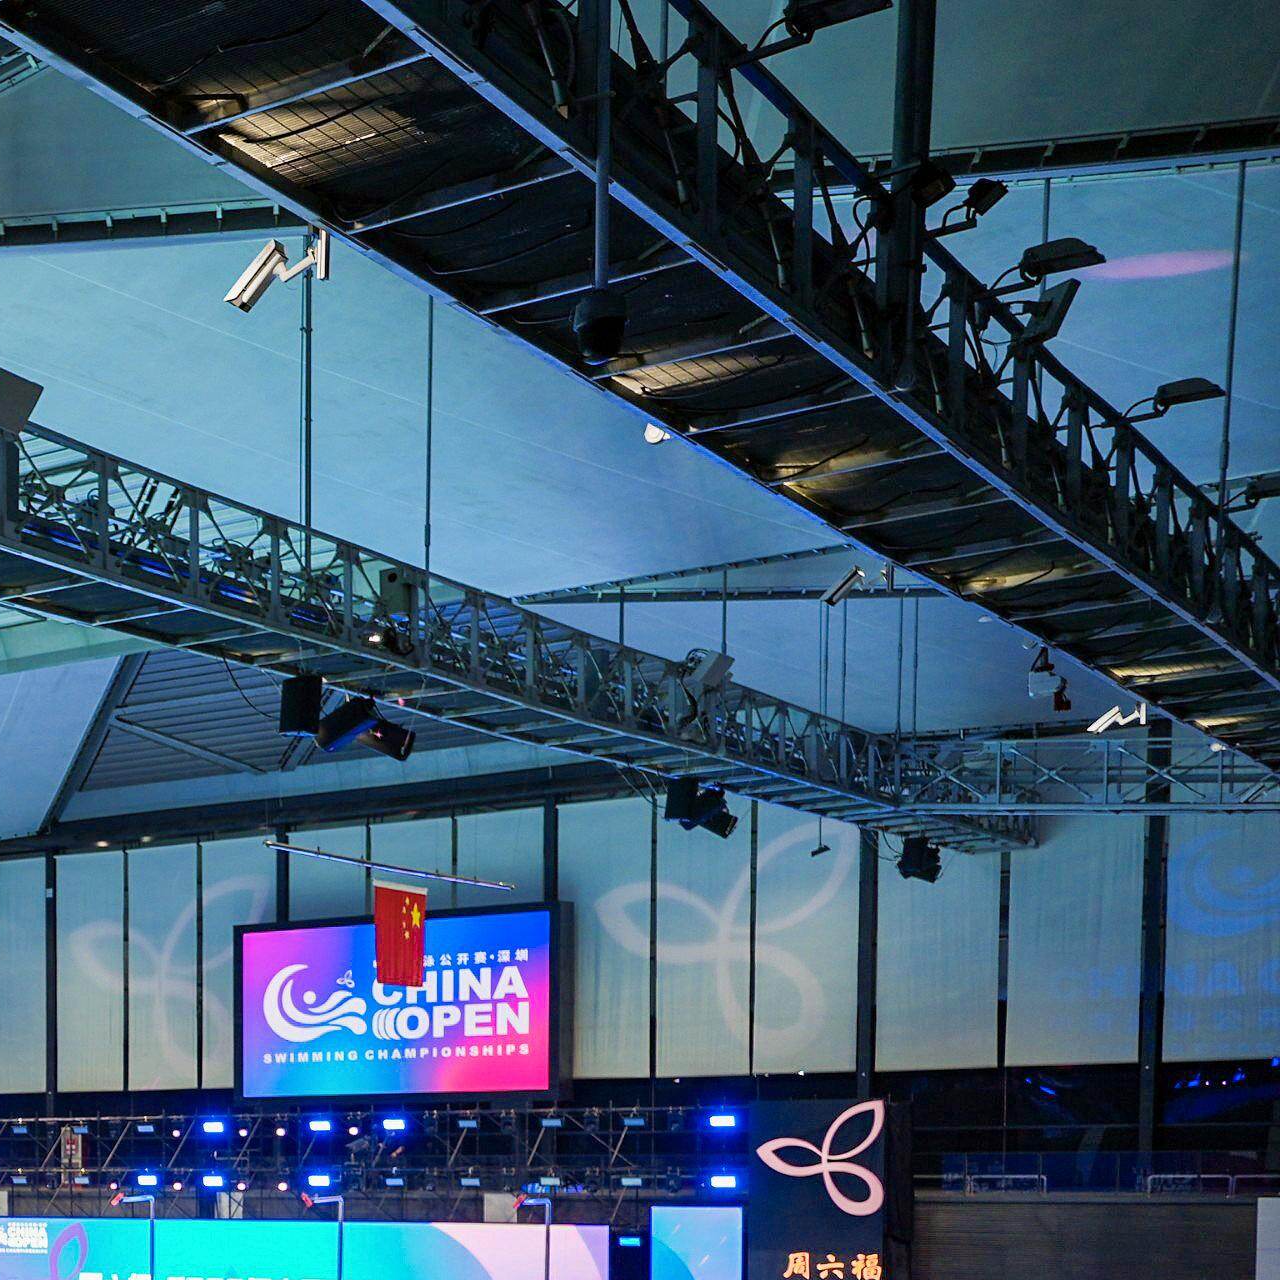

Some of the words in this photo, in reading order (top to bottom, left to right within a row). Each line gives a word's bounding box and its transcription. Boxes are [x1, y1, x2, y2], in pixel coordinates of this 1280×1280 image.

[372, 965, 529, 1006] CHINA
[390, 1001, 530, 1040] OPEN
[262, 1050, 358, 1064] SWIMMING
[365, 1043, 530, 1061] CHAMPIONSHIPS
[782, 1251, 883, 1280] 周六福
